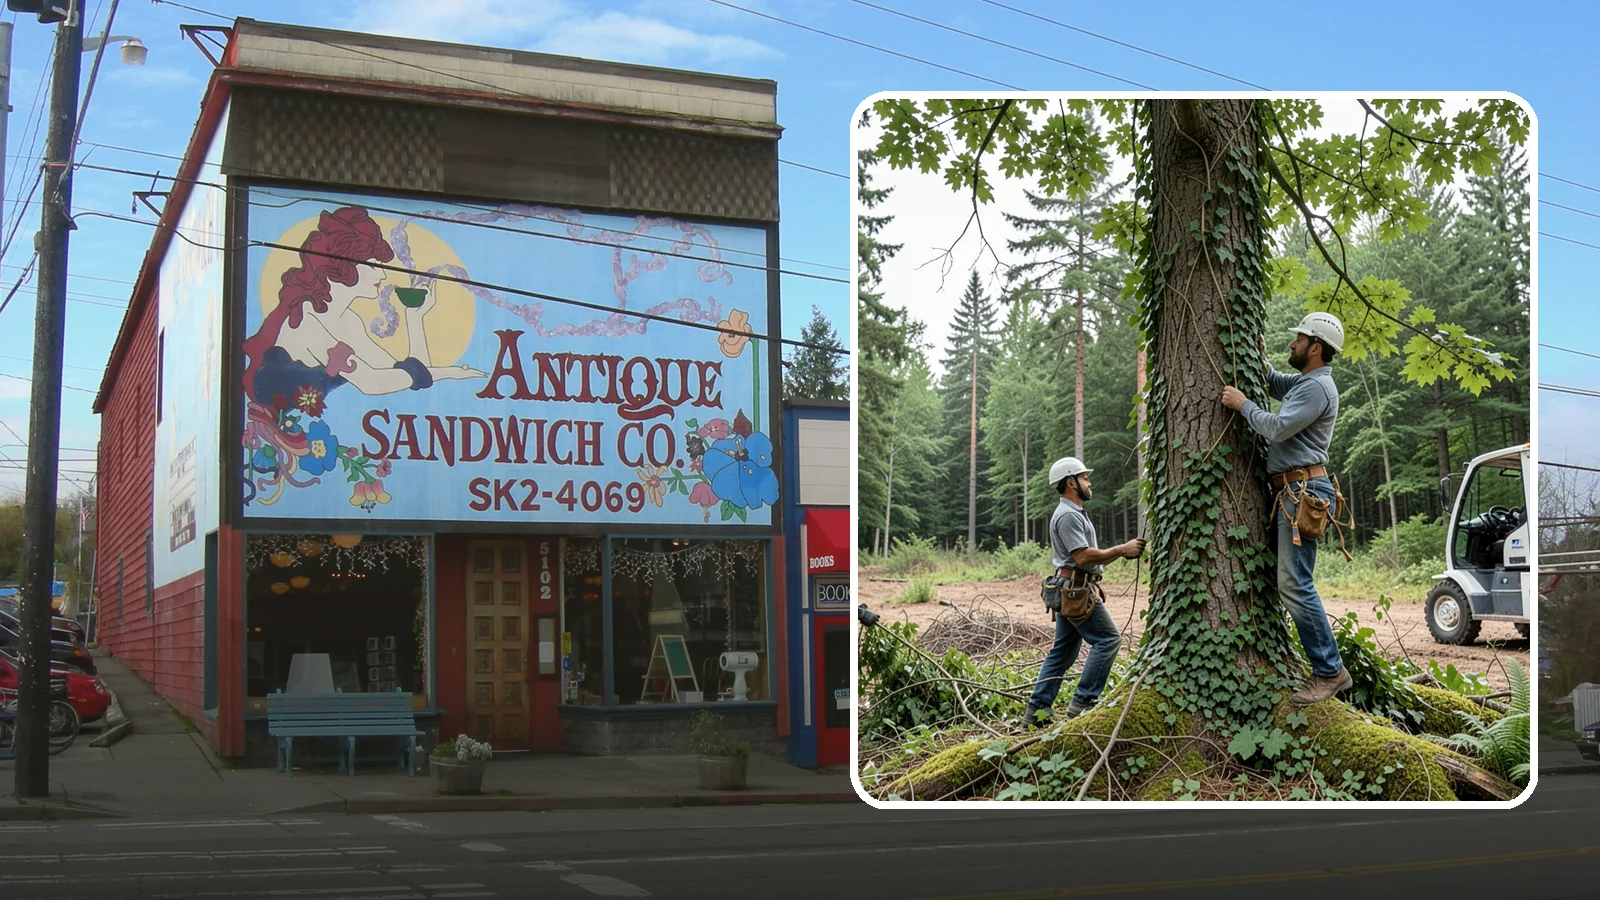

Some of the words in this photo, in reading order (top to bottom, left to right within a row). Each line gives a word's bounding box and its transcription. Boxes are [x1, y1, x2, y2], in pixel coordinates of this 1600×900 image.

[476, 329, 723, 421] ANTIQUE
[361, 408, 604, 467] SANDWICH
[616, 422, 685, 469] CO.
[469, 477, 645, 513] SK2-4069
[540, 541, 551, 600] 5102
[809, 555, 835, 569] BOOKS
